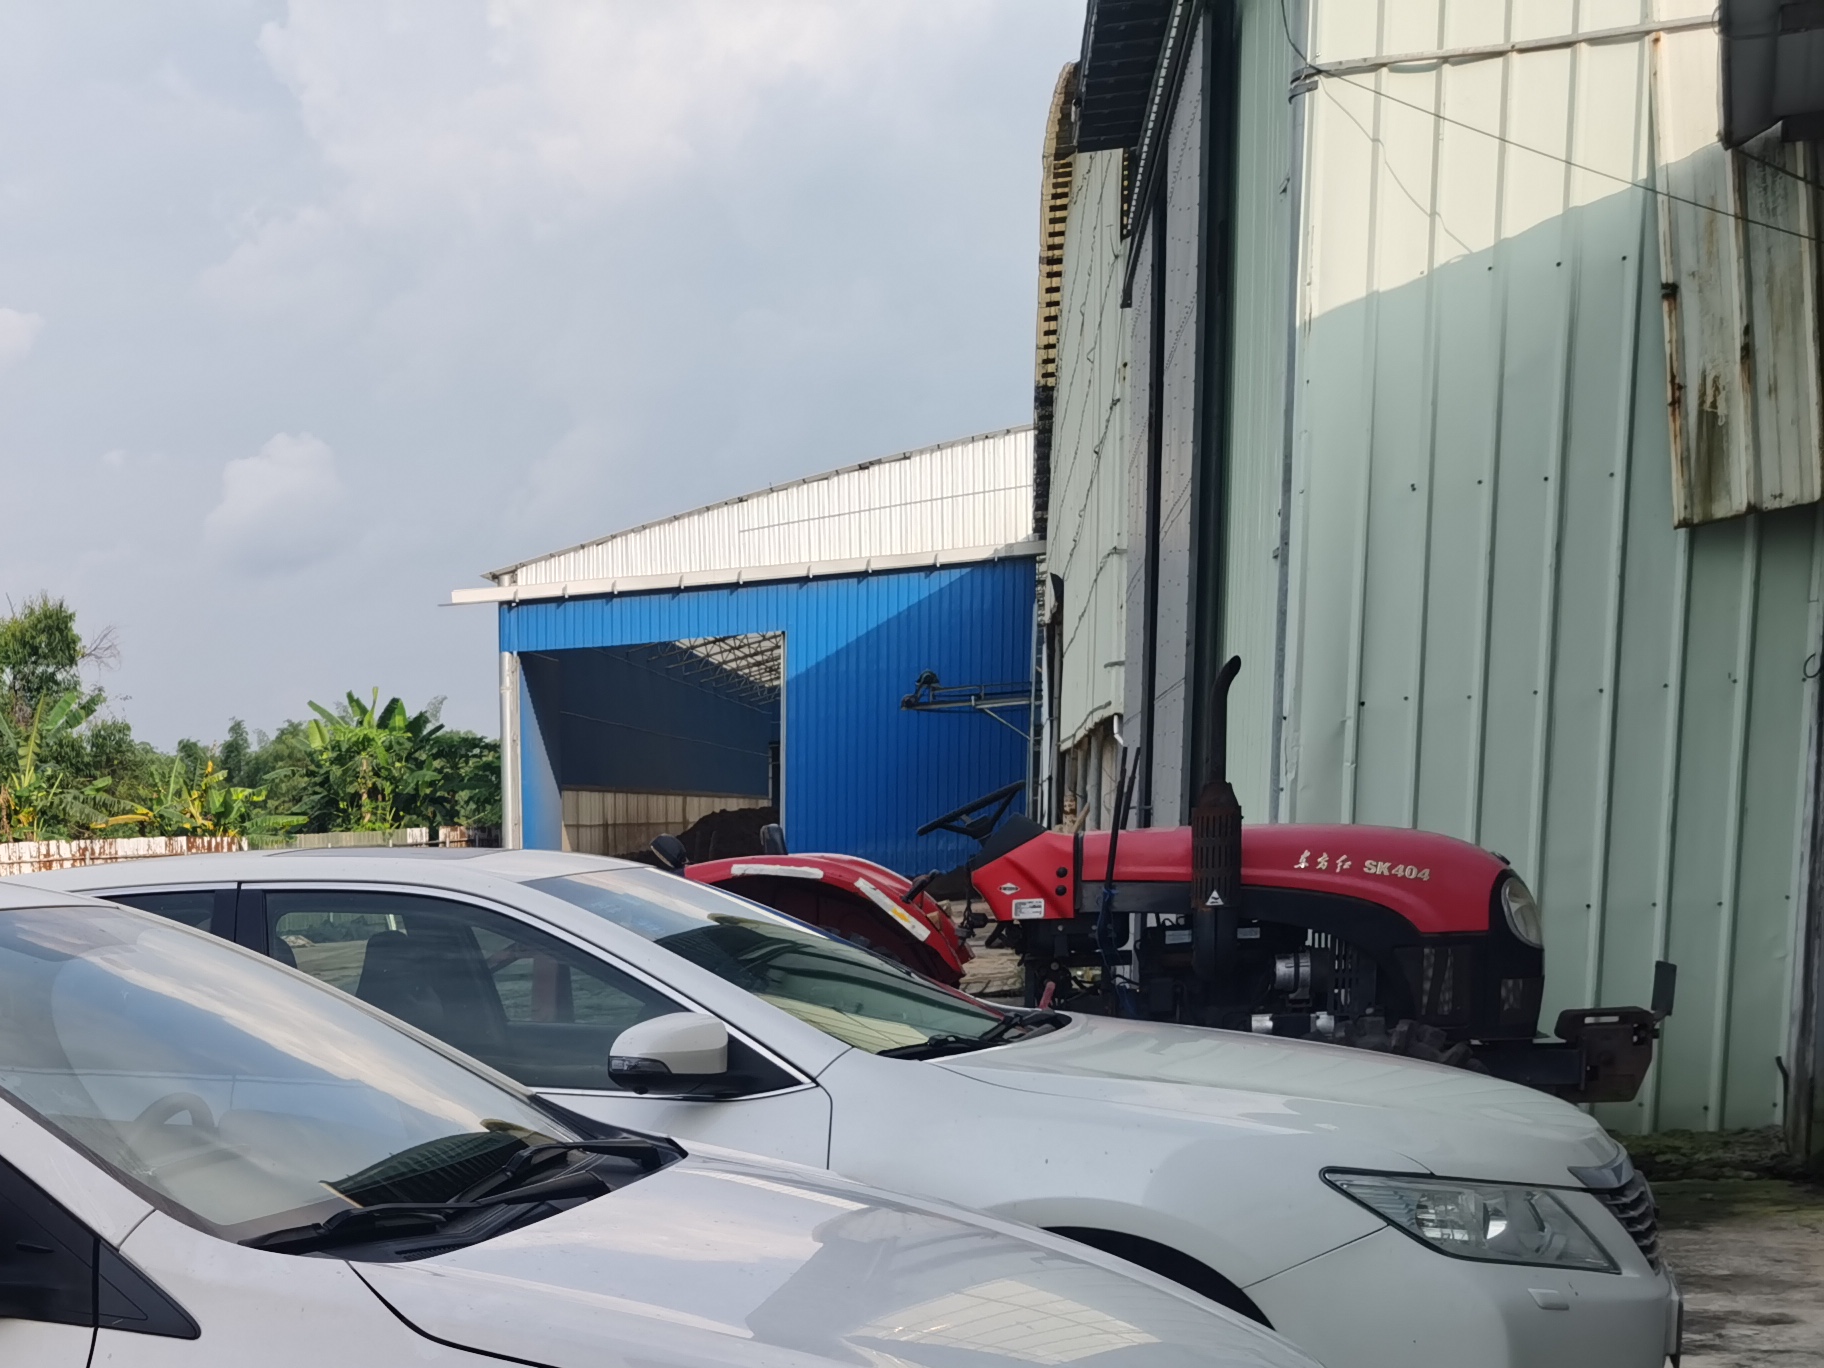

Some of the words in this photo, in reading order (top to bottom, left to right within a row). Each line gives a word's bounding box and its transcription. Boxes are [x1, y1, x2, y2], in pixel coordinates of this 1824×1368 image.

[1294, 849, 1352, 873] 东方红
[1363, 859, 1431, 881] SK404
